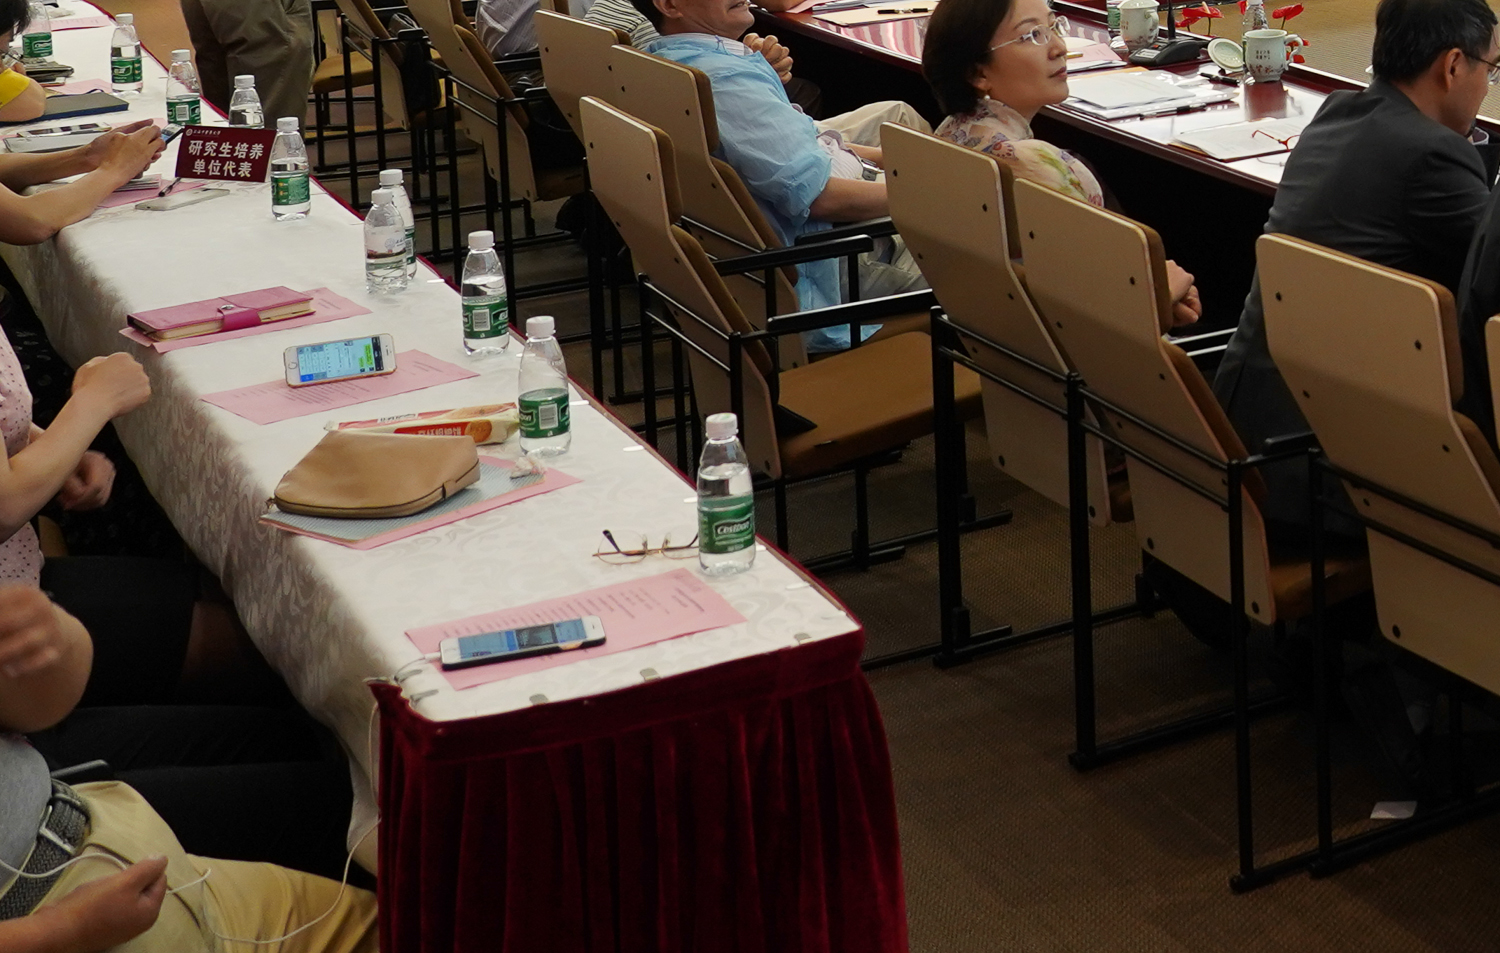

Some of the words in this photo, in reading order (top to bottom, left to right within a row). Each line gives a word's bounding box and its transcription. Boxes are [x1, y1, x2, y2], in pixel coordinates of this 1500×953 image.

[188, 140, 265, 160] 研究生培养
[192, 159, 253, 178] 单位代表
